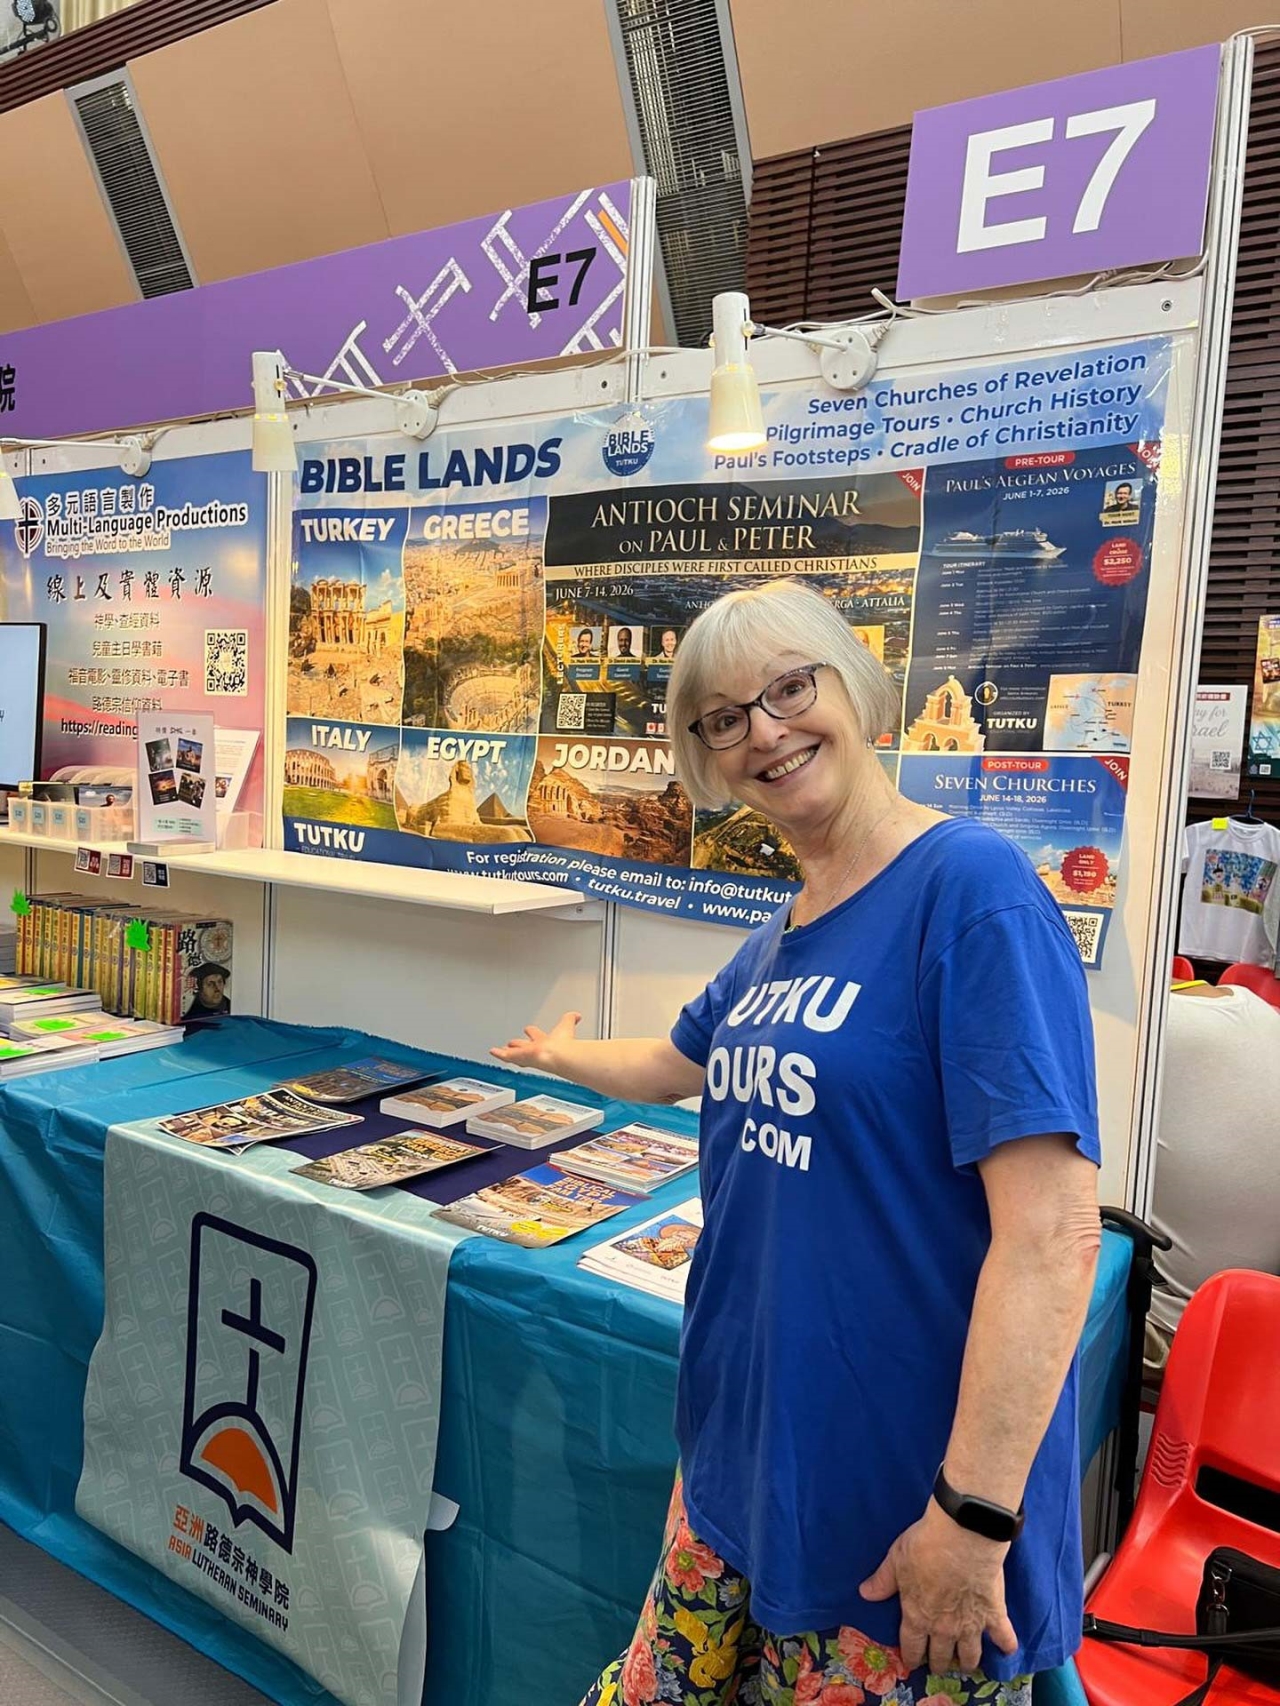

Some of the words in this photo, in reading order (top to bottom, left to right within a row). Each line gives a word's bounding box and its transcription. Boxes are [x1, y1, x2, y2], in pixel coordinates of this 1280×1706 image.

[957, 99, 1157, 254] E7
[527, 247, 597, 314] E7
[808, 396, 867, 414] Seven
[875, 382, 978, 409] Churches
[985, 374, 1009, 393] of
[1015, 353, 1146, 390] Revelation
[766, 421, 875, 444] Pilgrimage
[882, 415, 940, 434] Tours
[960, 397, 1042, 425] Church
[1050, 383, 1142, 412] History
[608, 430, 649, 447] BIBLE
[608, 441, 648, 457] LANDS
[714, 451, 767, 470] Paul's
[772, 445, 870, 468] Footsteps
[890, 435, 959, 458] Cradle
[965, 430, 990, 447] of
[995, 412, 1139, 444] Christianity
[300, 454, 406, 494] BIBLE
[418, 437, 563, 490] LANDS
[1015, 454, 1065, 467] PRE-TOUR
[902, 472, 921, 492] JOIN
[996, 472, 1057, 489] AEGEAN
[1063, 462, 1136, 480] VOYAGES
[48, 485, 154, 516] 多元語言製作
[1003, 491, 1027, 501] JUNE
[1029, 489, 1044, 499] 1-7,
[1046, 487, 1069, 497] 2026
[47, 513, 151, 537] Multi-Language
[157, 503, 246, 528] Productions
[591, 496, 717, 528] ANTIOCH
[727, 490, 862, 522] SEMINAR
[301, 517, 396, 543] TURKEY
[423, 508, 529, 540] GREECE
[47, 538, 79, 557] Bringing
[81, 537, 94, 552] the
[95, 536, 117, 551] Word
[119, 537, 127, 550] to
[129, 535, 143, 549] the
[145, 532, 169, 548] World
[619, 539, 643, 554] ON
[650, 528, 711, 553] PAUL
[718, 540, 728, 551] &
[735, 525, 816, 551] PETER
[575, 564, 613, 577] WHERE
[615, 561, 669, 575] DISCIPLES
[673, 561, 705, 574] WERE
[708, 559, 741, 573] FIRST
[744, 559, 791, 572] CALLED
[795, 557, 878, 571] CHRISTIANS
[46, 566, 213, 602] 線上及實體資源
[555, 586, 582, 600] JUNE
[585, 585, 606, 598] 7-14,
[608, 584, 633, 597] 2026
[862, 597, 905, 608] ATTALIA
[987, 718, 1037, 729] TUTKU
[1208, 706, 1226, 721] for
[312, 725, 370, 753] ITALY
[427, 736, 506, 764] EGYPT
[552, 743, 675, 775] JORDAN
[987, 760, 1042, 770] POST-TOUR
[1104, 758, 1127, 781] JOIN
[934, 774, 988, 791] SEVEN
[993, 775, 1096, 793] CHURCHES
[979, 794, 1000, 802] JUNE
[1002, 794, 1025, 804] 14-18,
[1026, 795, 1047, 804] 2026
[294, 822, 365, 853] TUTKU
[467, 851, 489, 865] For
[494, 849, 566, 866] registration
[568, 858, 617, 879] please
[620, 870, 662, 887] email
[665, 877, 686, 890] to:
[588, 877, 681, 910] tutku.travel
[707, 1045, 816, 1116] OURS
[741, 1118, 812, 1171] COM
[174, 1504, 289, 1611] 亞洲路德宗神學院
[168, 1536, 192, 1559] ASIA
[192, 1549, 236, 1596] LUTHERAN
[238, 1586, 288, 1631] SEMINARY
